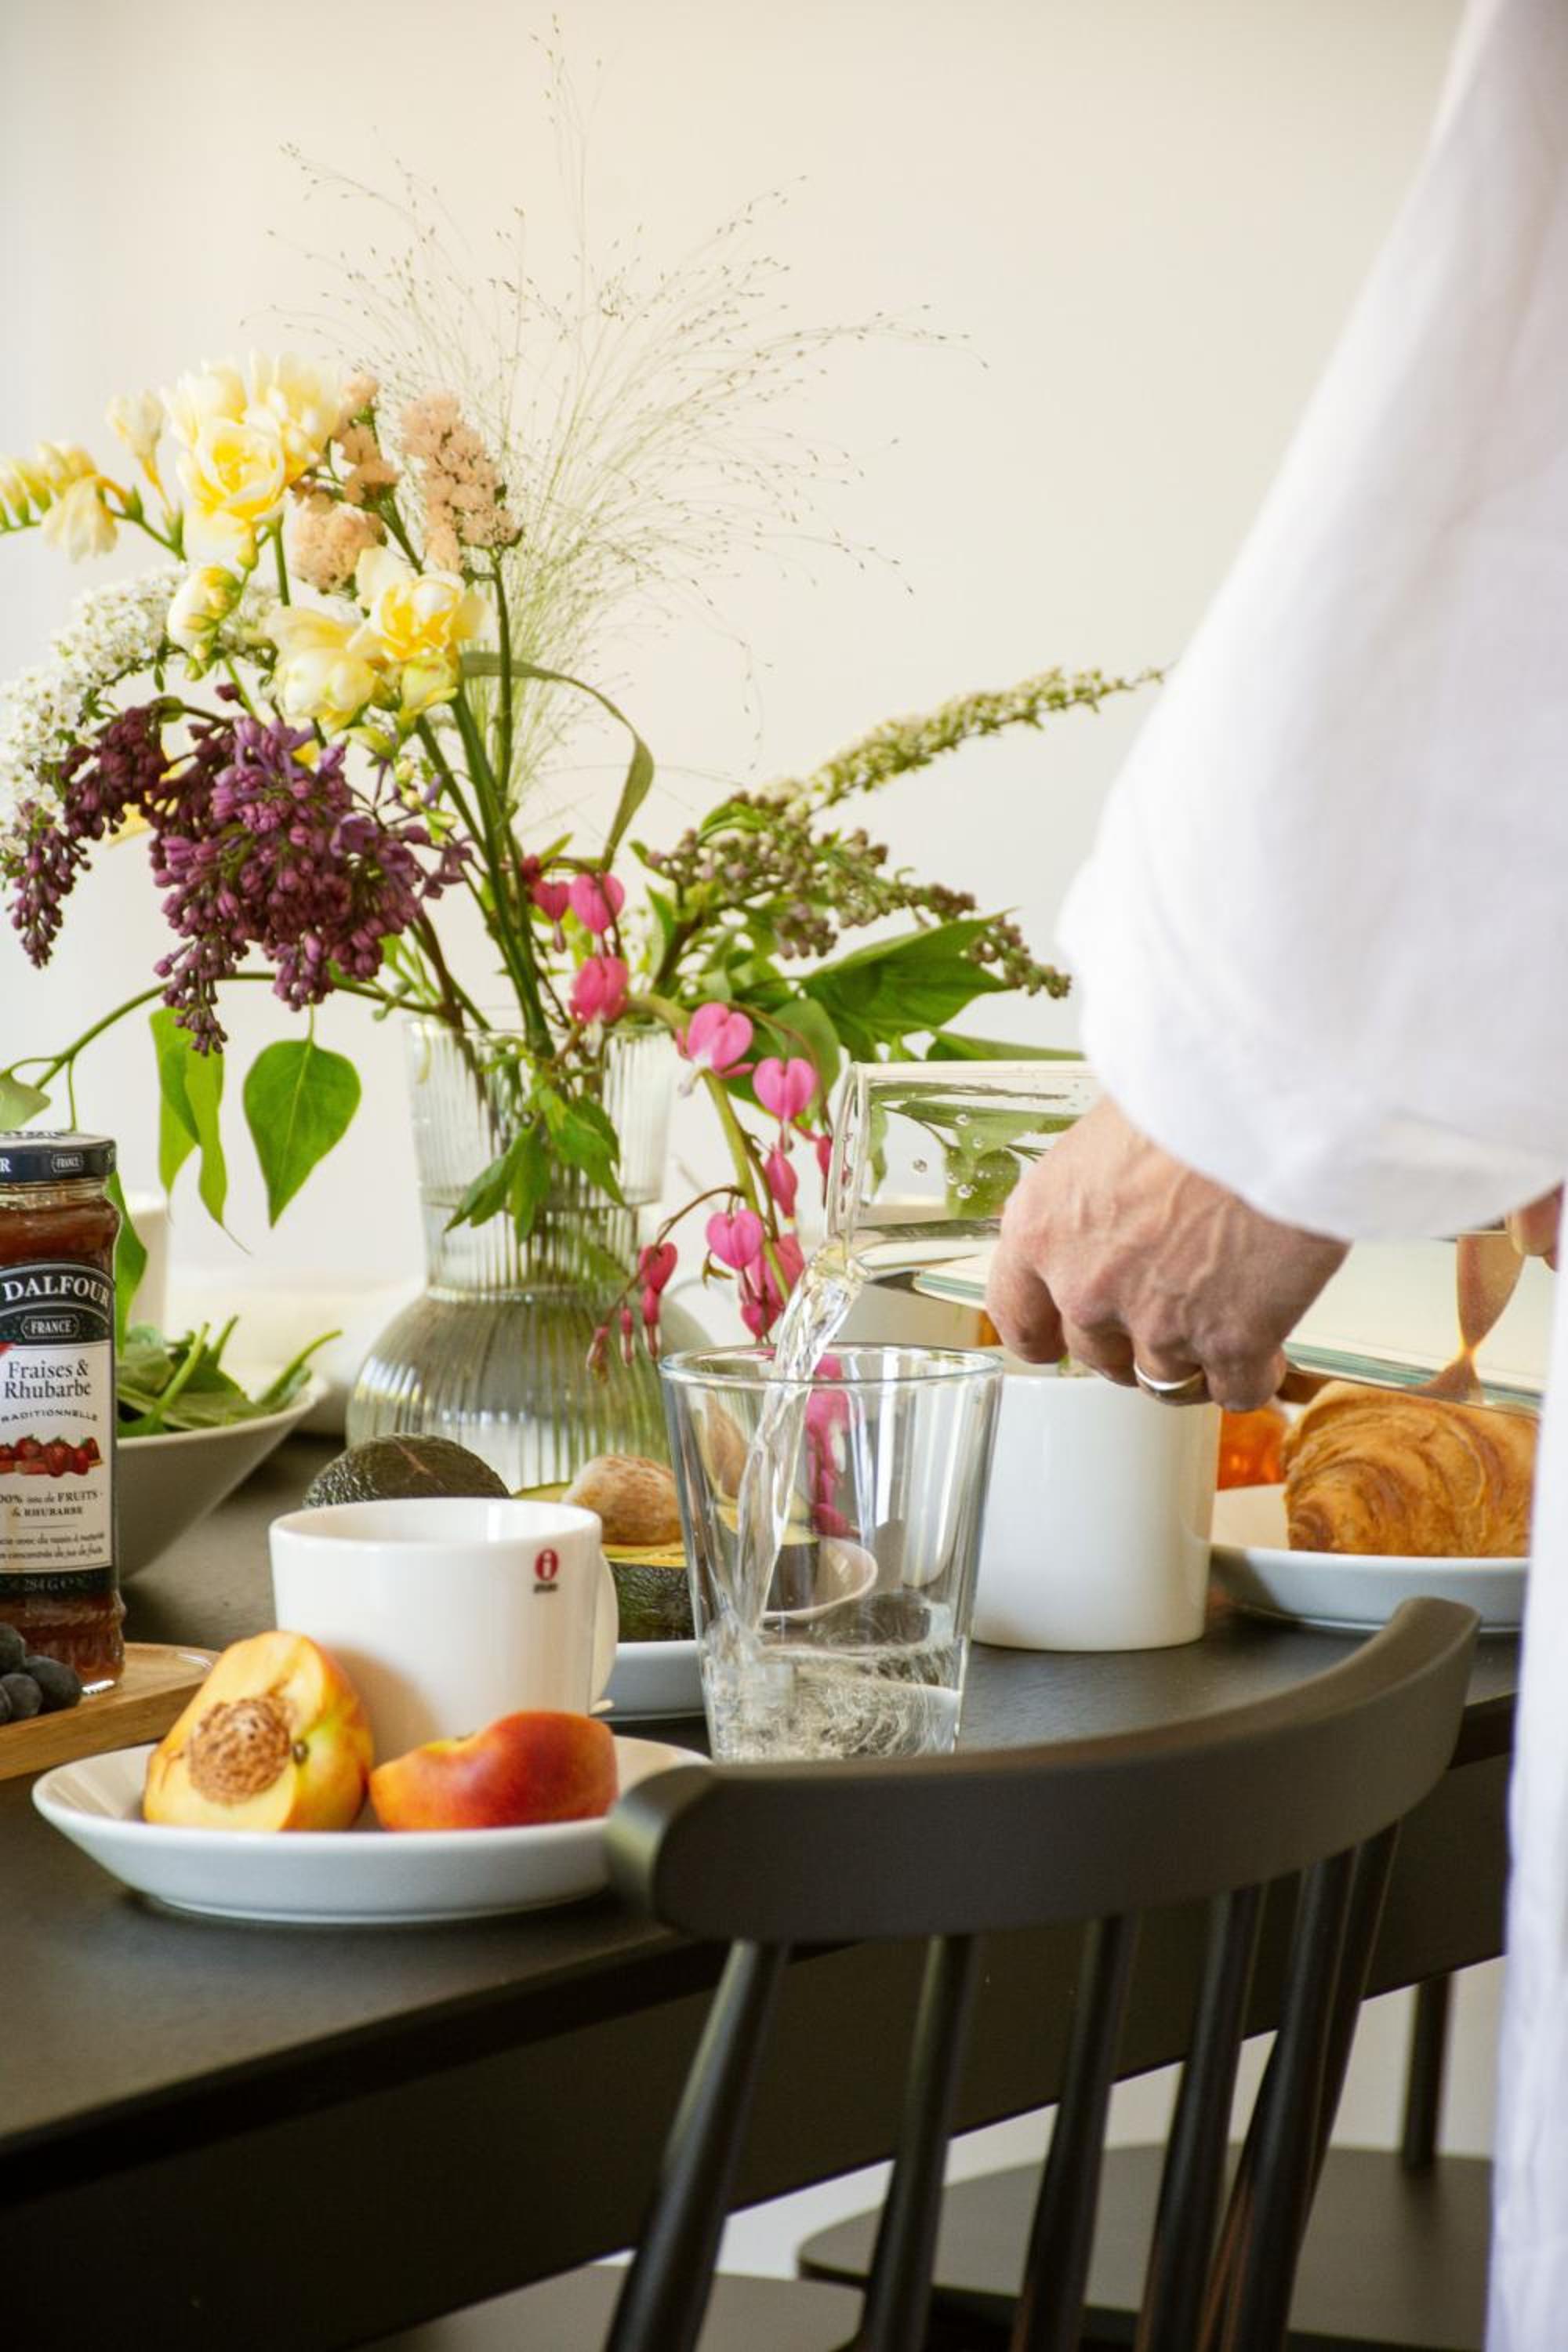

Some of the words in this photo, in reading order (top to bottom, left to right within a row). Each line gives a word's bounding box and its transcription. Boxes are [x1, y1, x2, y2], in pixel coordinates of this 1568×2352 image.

[3, 1276, 109, 1308] DALFOUR
[31, 1319, 72, 1334] FRANCE
[9, 1359, 73, 1379] Fraises
[76, 1359, 89, 1377] &
[5, 1380, 92, 1399] Rhubarbe
[57, 1490, 98, 1503] FRUITS
[24, 1506, 82, 1517] RHUBARBE
